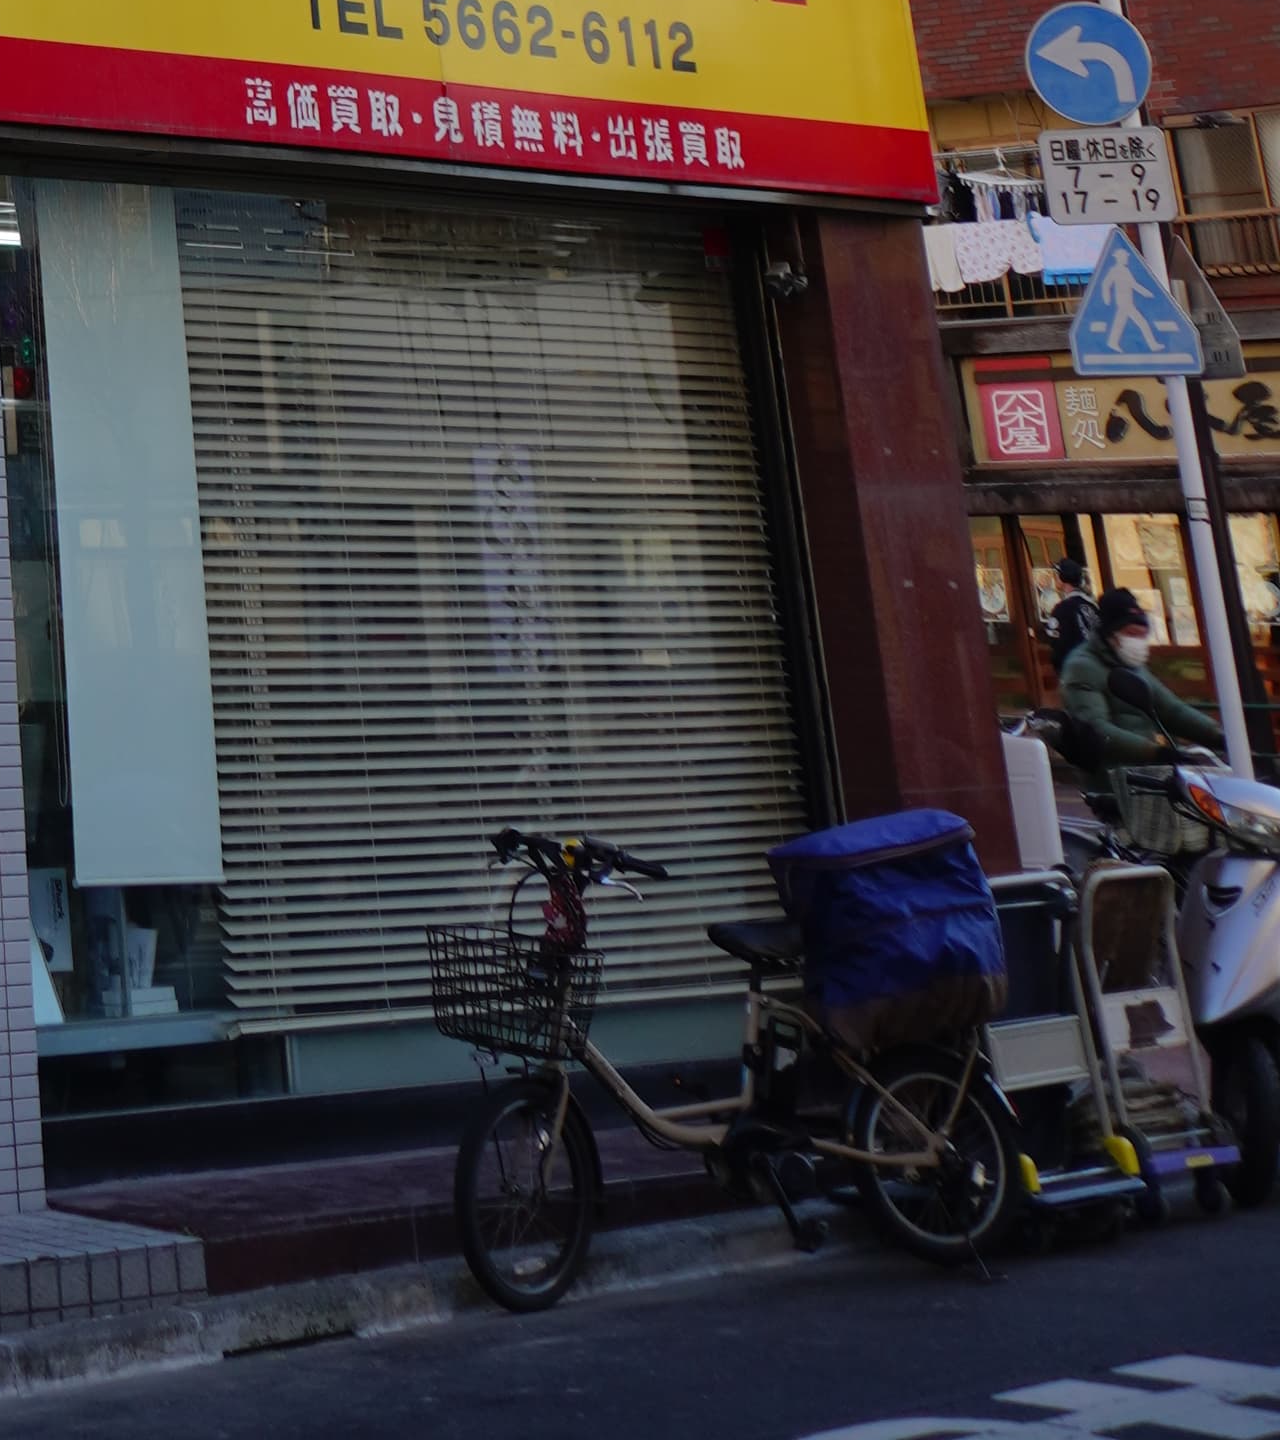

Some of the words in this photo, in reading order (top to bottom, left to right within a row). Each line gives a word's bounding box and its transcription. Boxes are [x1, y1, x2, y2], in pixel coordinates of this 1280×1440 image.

[997, 391, 1048, 453] 八木屋
[1063, 386, 1106, 450] 麺処
[1106, 379, 1280, 443] 八屋
